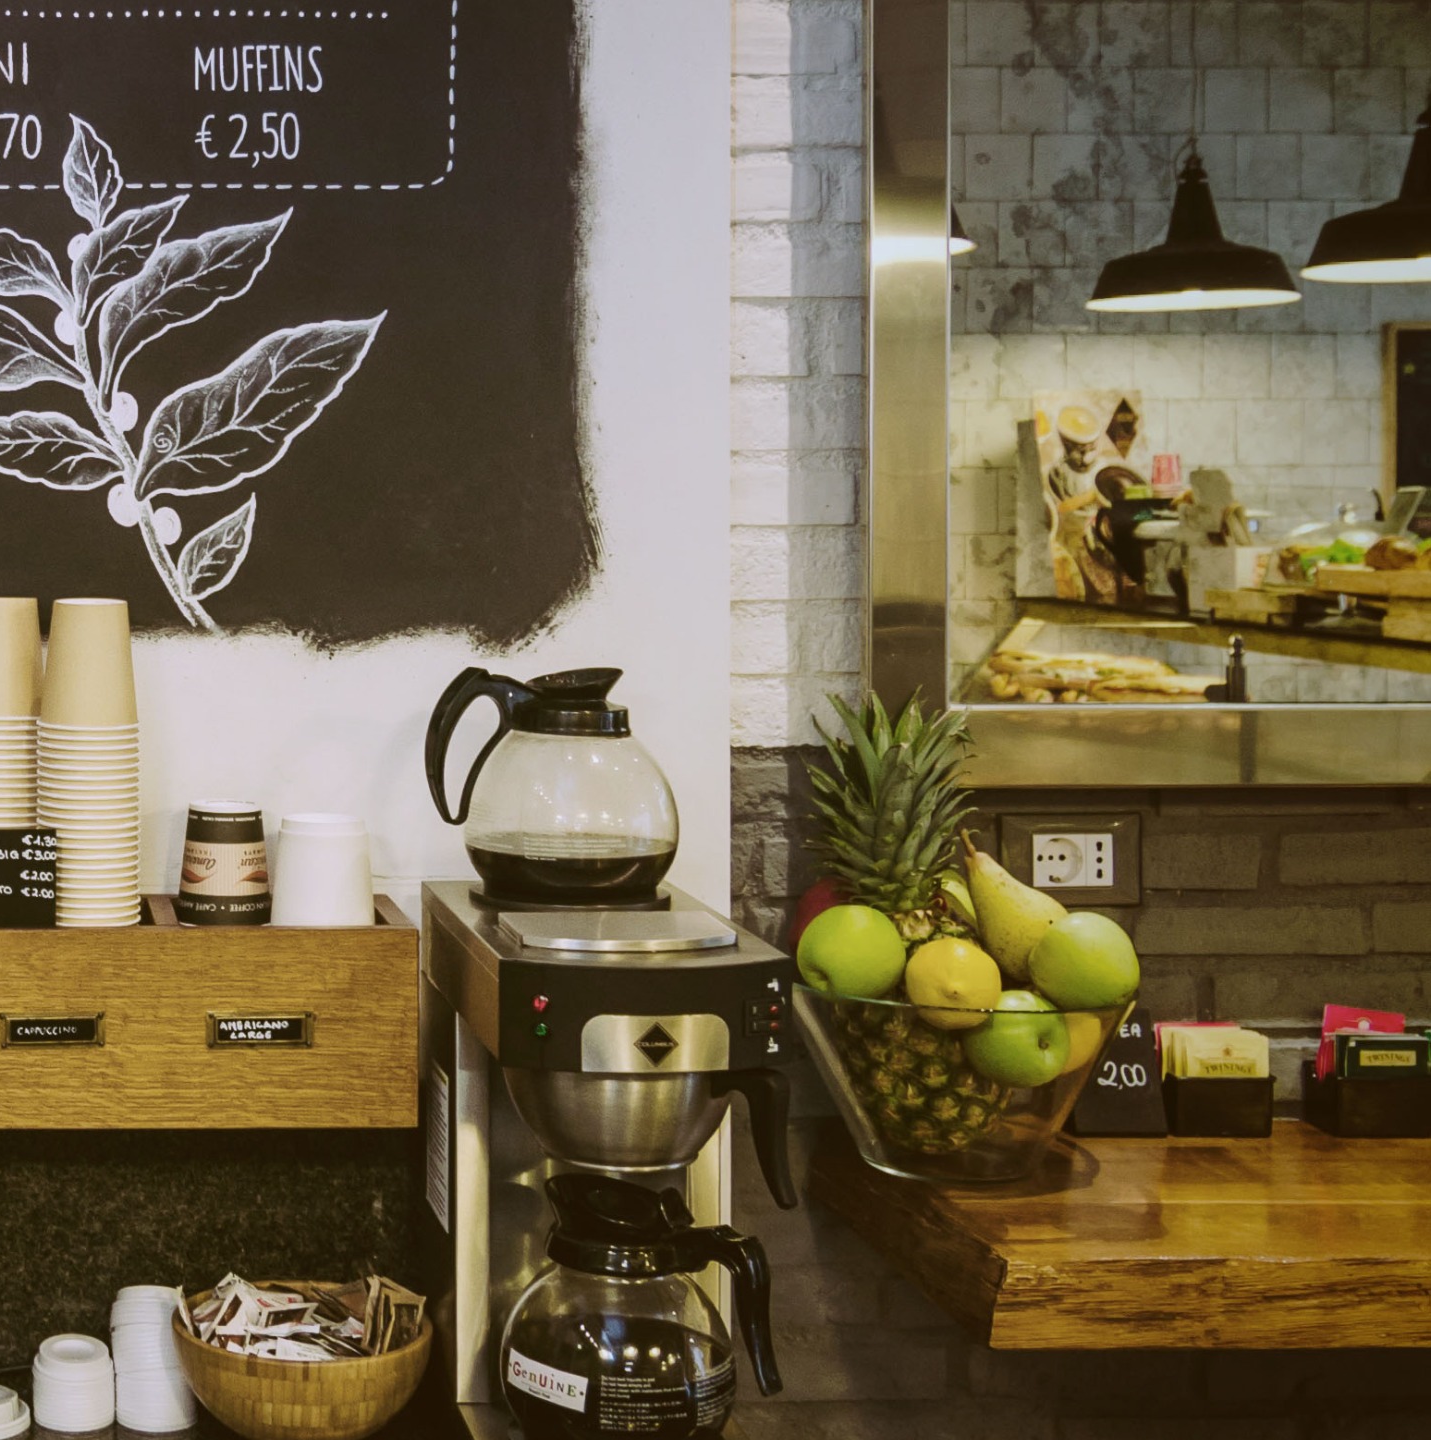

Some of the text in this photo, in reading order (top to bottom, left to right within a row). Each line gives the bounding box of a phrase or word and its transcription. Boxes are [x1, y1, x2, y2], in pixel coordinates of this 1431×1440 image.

[194, 44, 323, 93] MUFFINS
[16, 1026, 78, 1036] CAPPUCCINO
[219, 1020, 290, 1031] AMERICANO
[1119, 1022, 1141, 1038] EA
[229, 1030, 272, 1040] LARGE
